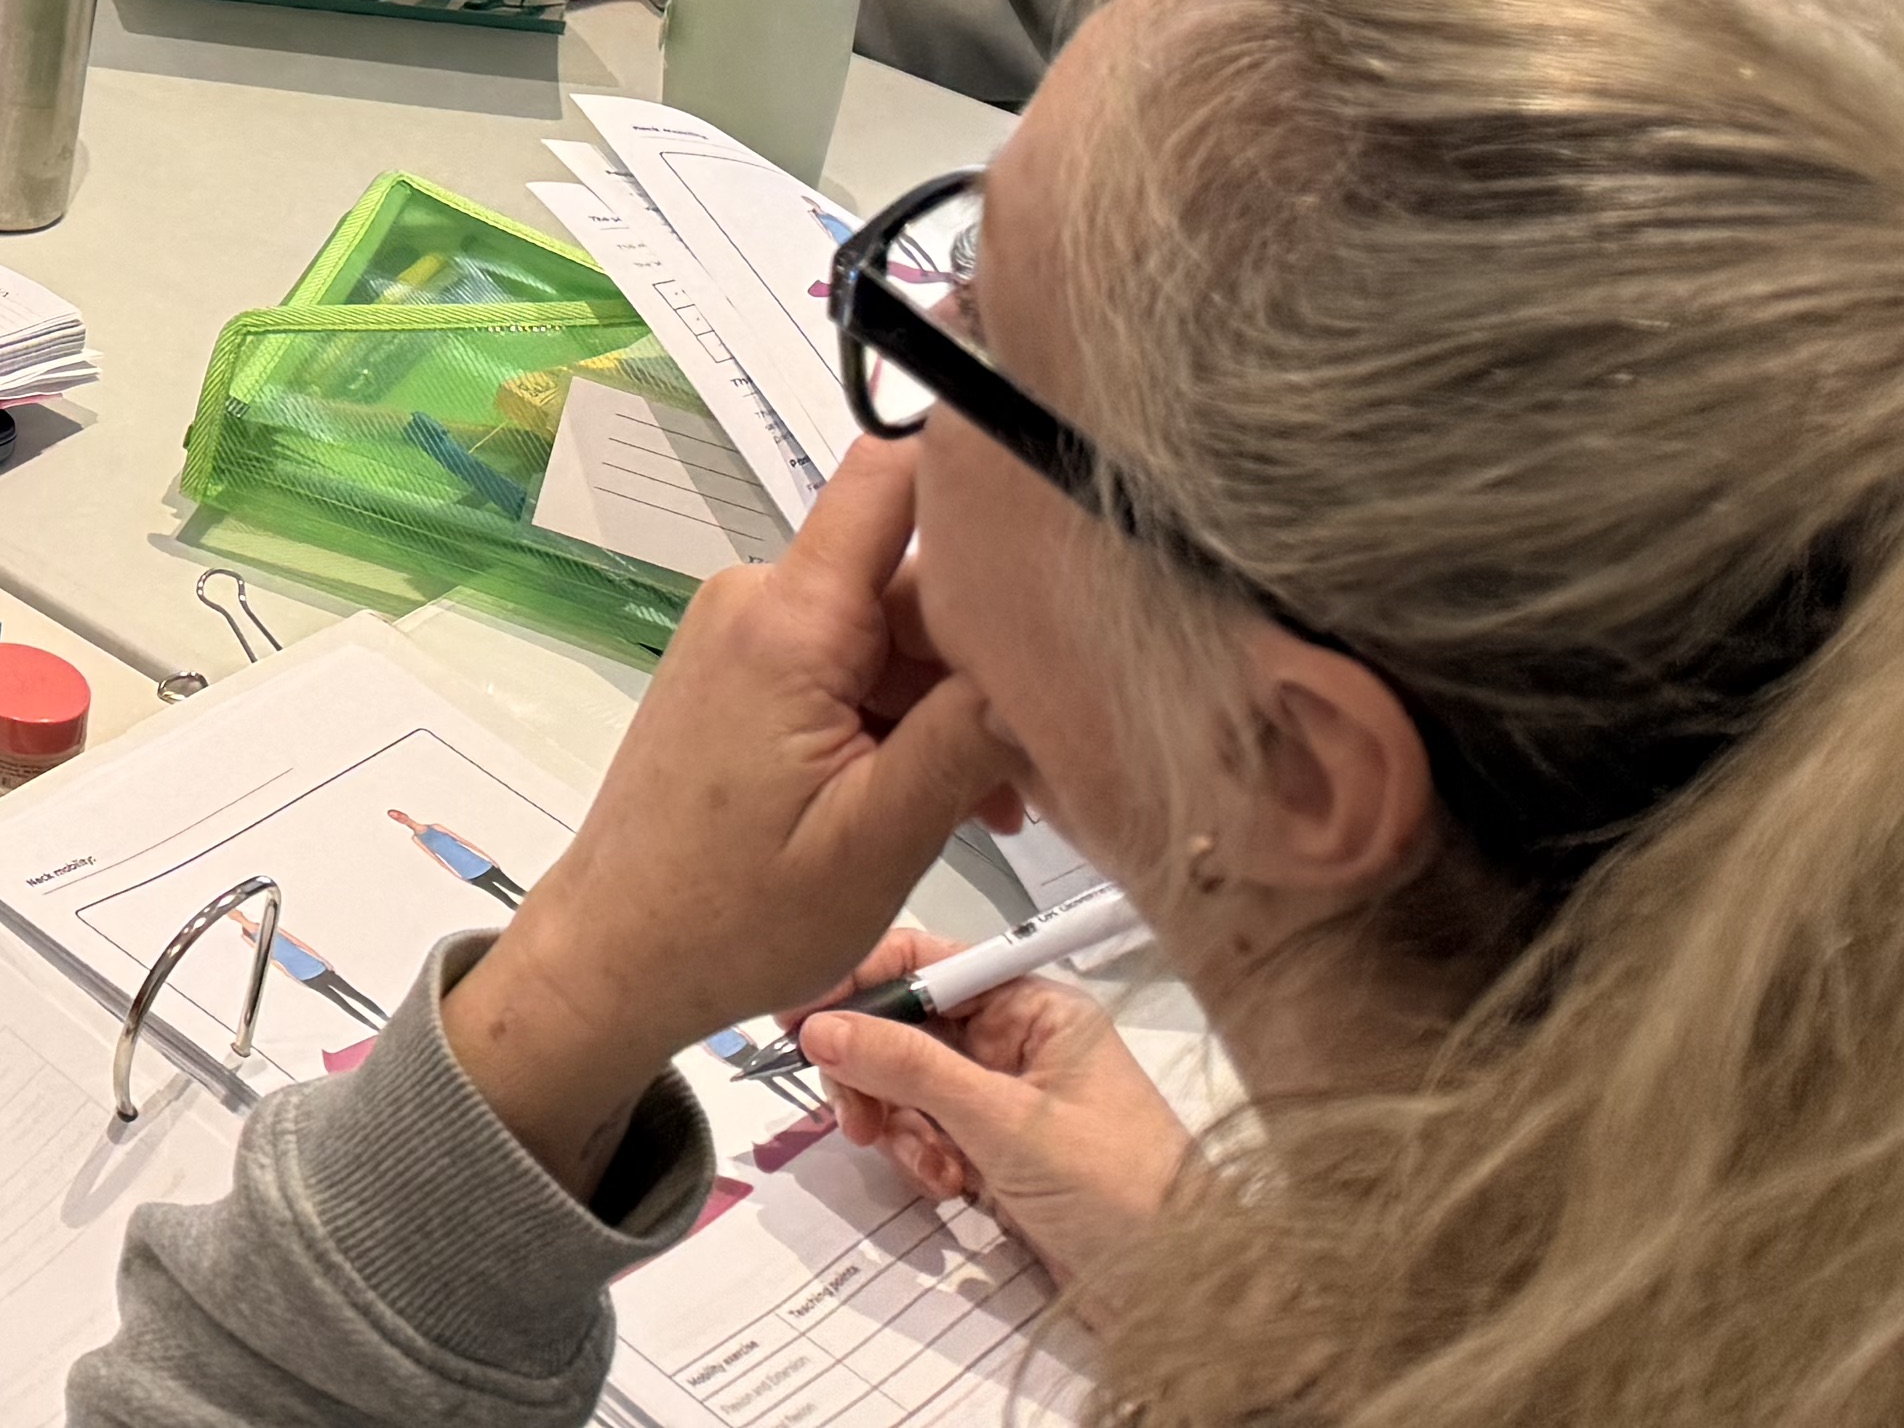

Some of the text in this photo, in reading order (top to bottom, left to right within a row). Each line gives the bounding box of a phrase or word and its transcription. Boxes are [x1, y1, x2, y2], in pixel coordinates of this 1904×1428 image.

[26, 874, 55, 887] Neck
[724, 1340, 759, 1366] exercise
[787, 1287, 833, 1318] Teaching
